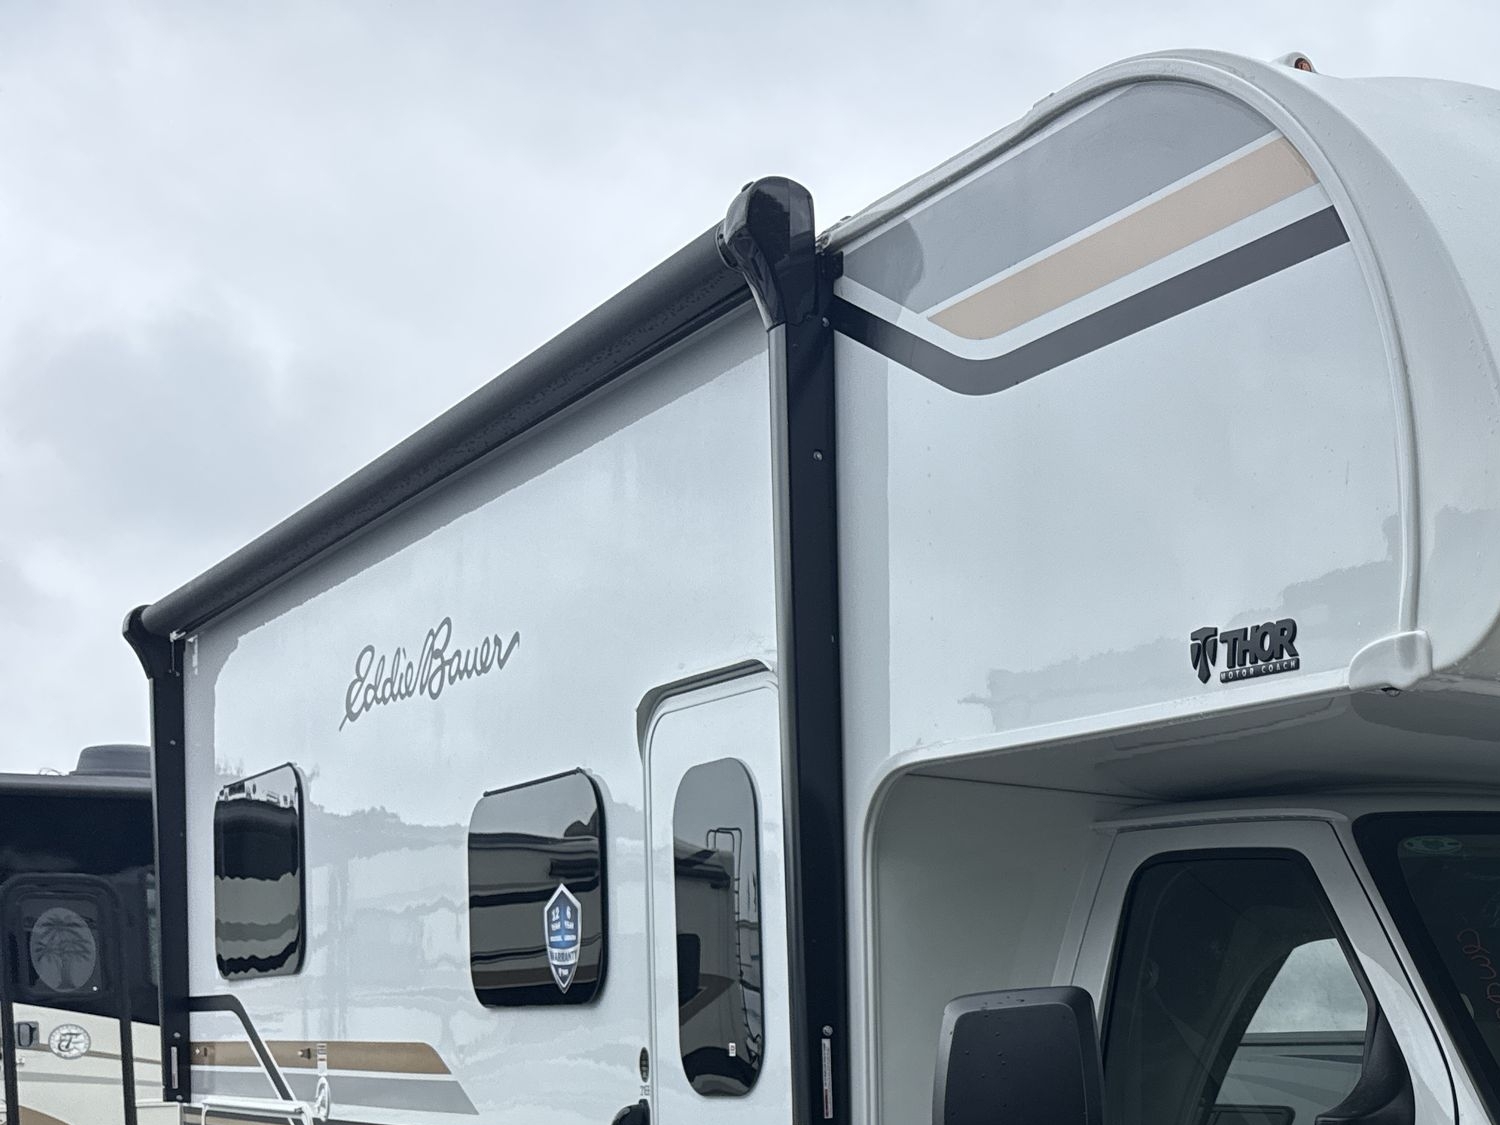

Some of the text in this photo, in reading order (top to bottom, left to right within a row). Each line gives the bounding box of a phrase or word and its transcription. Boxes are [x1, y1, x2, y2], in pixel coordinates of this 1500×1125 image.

[1219, 618, 1300, 670] THOR
[338, 616, 521, 732] Eddie Bauer
[1220, 660, 1297, 681] MOTOR COACH
